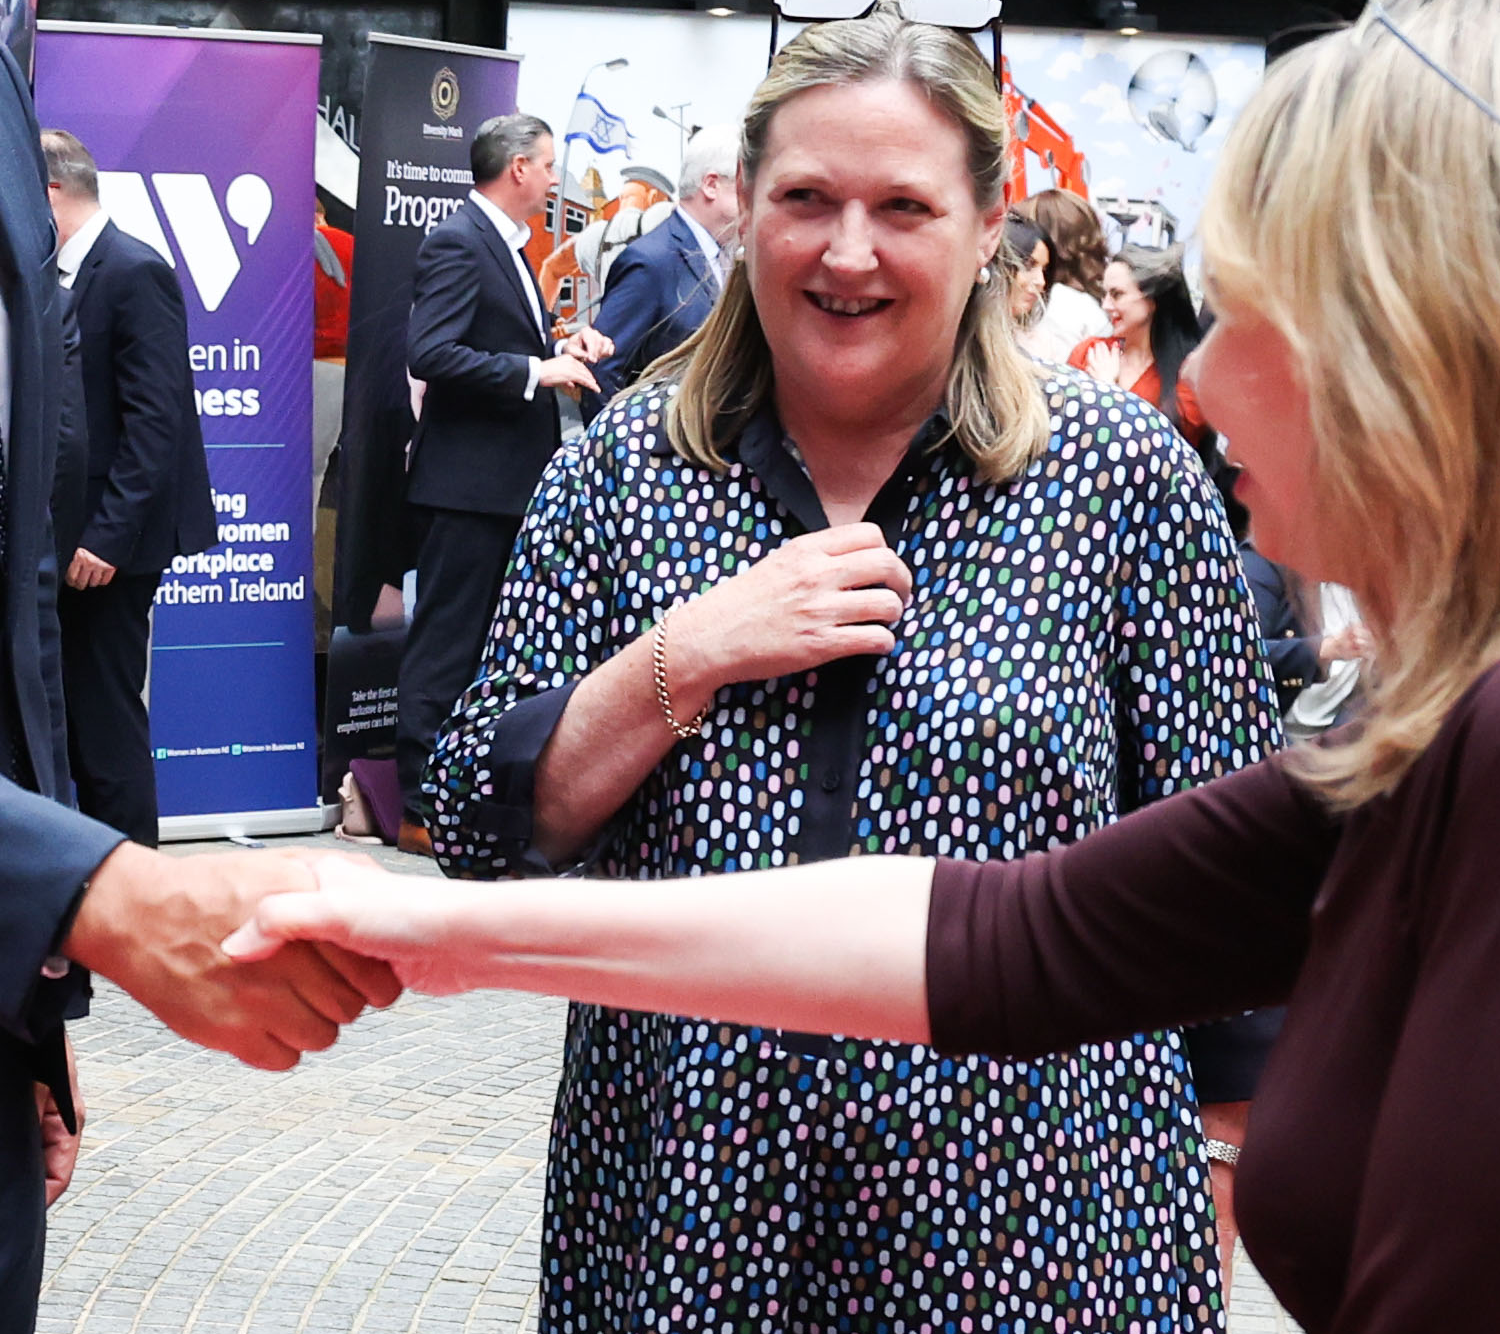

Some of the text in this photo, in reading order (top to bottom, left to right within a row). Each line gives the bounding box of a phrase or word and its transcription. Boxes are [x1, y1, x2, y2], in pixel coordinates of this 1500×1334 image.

[386, 160, 475, 184] It's time to comm
[383, 185, 465, 236] Progr
[189, 338, 260, 371] en in
[210, 489, 247, 519] ing
[163, 548, 274, 579] orkplace
[153, 576, 305, 605] rthern Ireland
